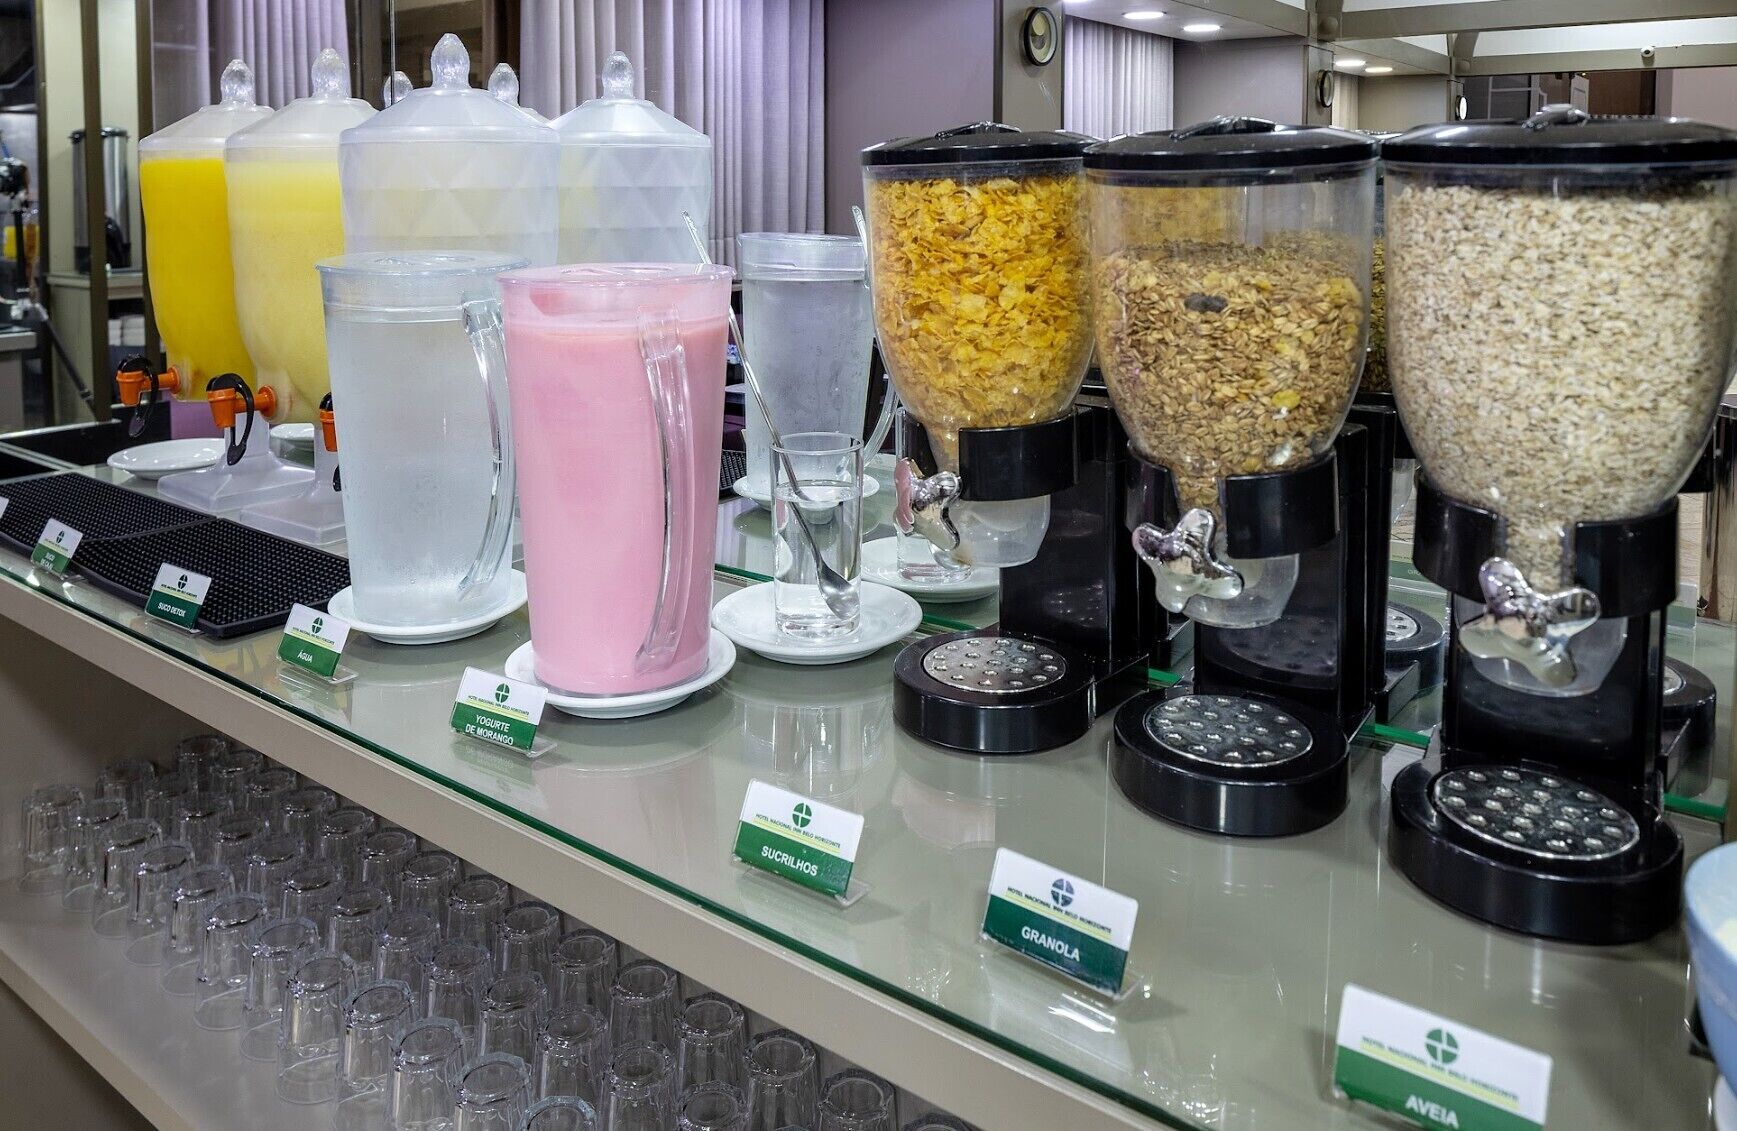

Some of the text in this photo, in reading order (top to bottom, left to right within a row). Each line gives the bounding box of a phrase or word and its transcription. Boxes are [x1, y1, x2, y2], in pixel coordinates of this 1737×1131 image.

[465, 723, 514, 746] DE MORANGO
[475, 714, 511, 732] YOGURTE
[755, 813, 769, 821] HOTEL
[769, 817, 792, 831] NACIONAL
[802, 830, 814, 839] BELO
[814, 833, 841, 848] HORIZONTE
[761, 845, 818, 876] SUCRILHOS
[1007, 886, 1023, 898] HOTEL
[1024, 893, 1051, 909] NACIONAL
[1064, 909, 1079, 920] BELO
[1079, 914, 1112, 934] HORIZONTE
[1021, 926, 1080, 962] GRANOLA
[1405, 1094, 1460, 1129] AVEIA
